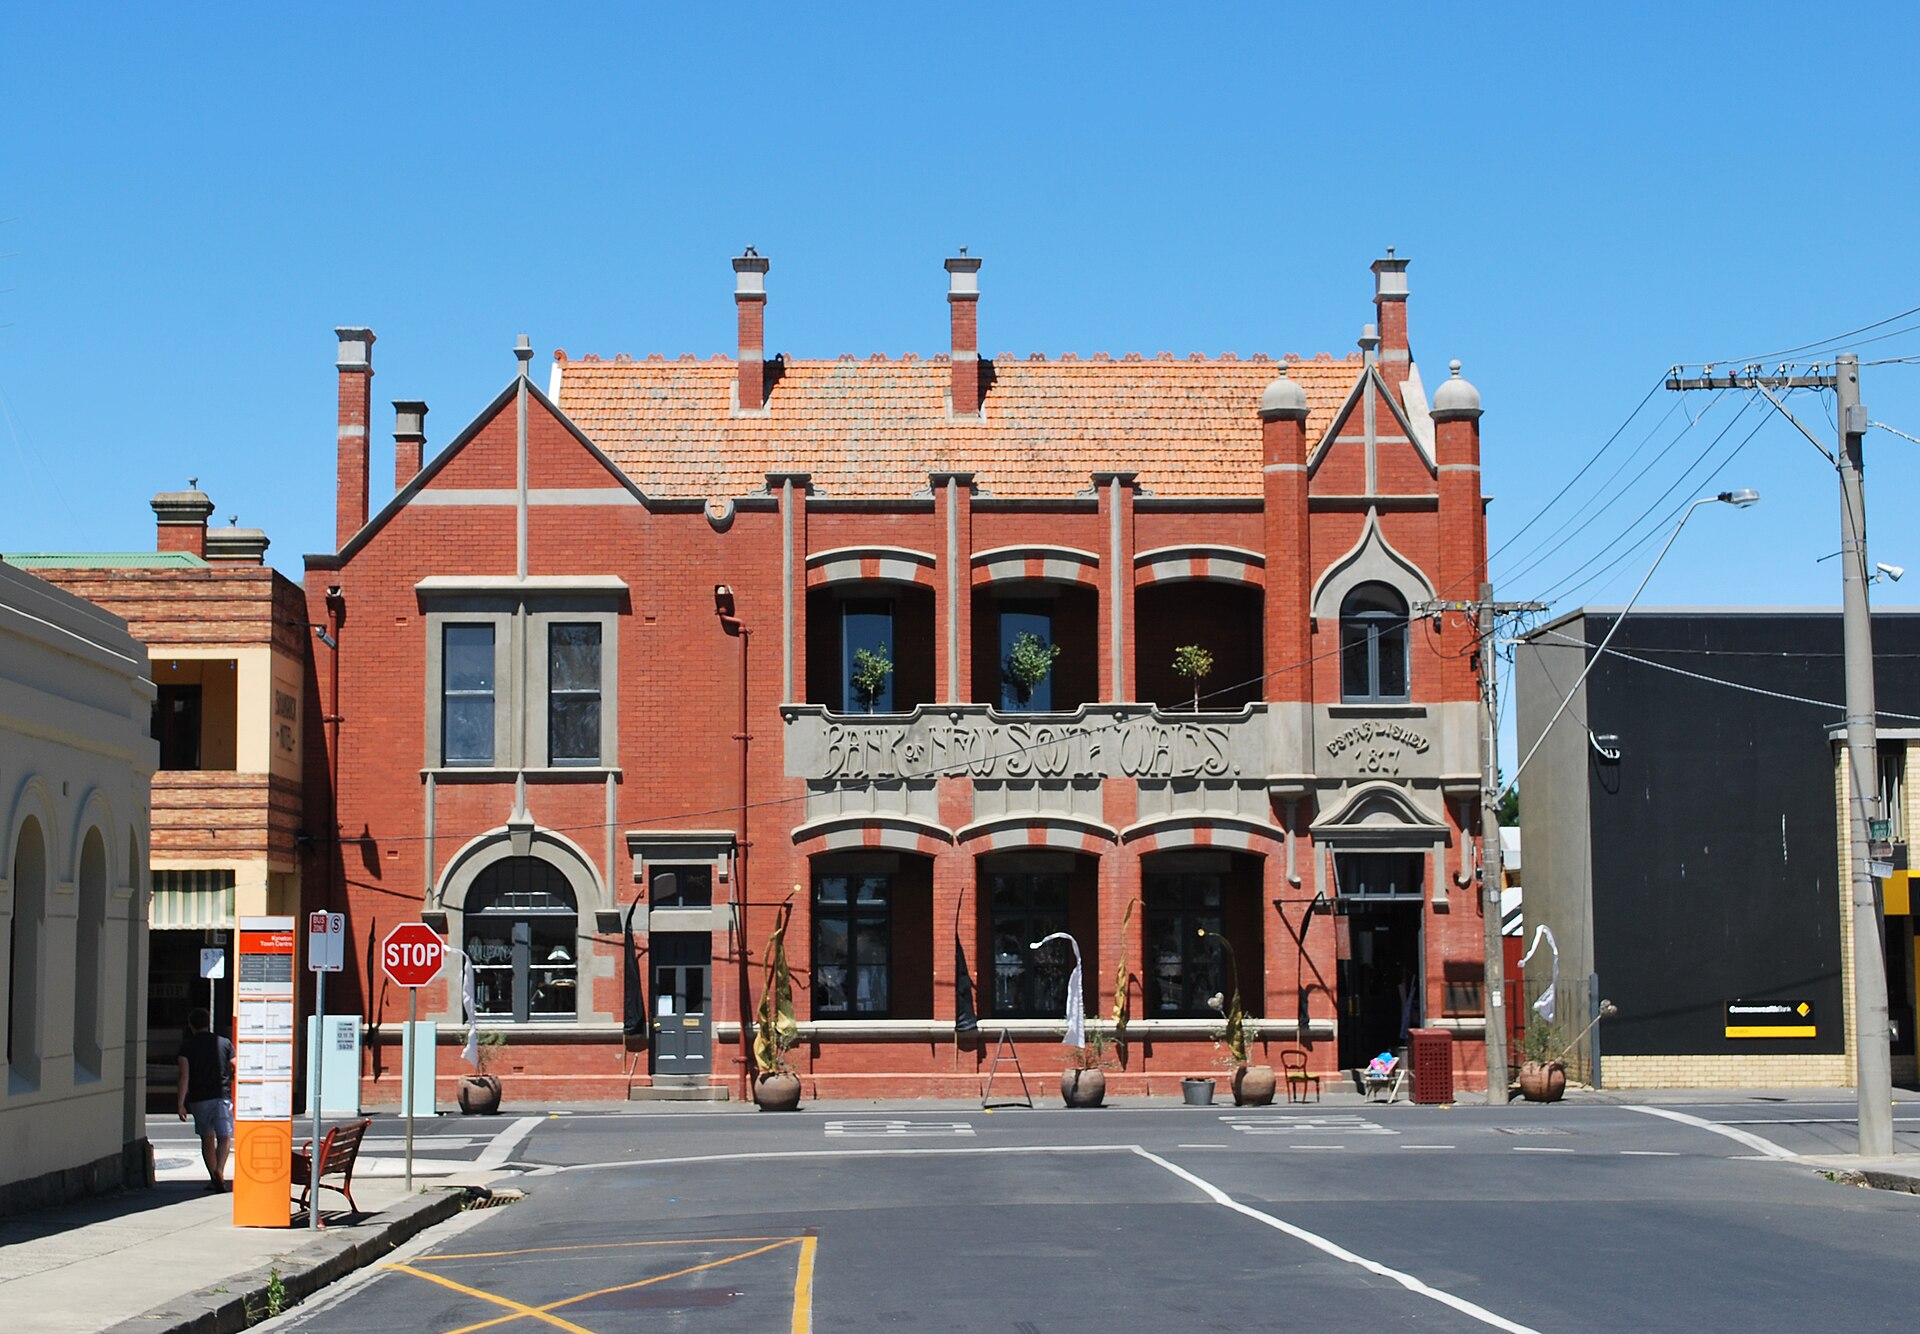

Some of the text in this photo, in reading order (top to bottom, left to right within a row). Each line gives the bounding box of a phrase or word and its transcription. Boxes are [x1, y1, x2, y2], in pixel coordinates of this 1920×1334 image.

[822, 723, 909, 780] BANK
[928, 727, 999, 779] NEW
[1005, 722, 1109, 779] SOUTH
[1326, 721, 1430, 758] ESTABLISHED
[1355, 748, 1400, 776] 1817
[312, 915, 325, 924] BUS
[313, 924, 325, 932] ZONE
[386, 943, 440, 967] STOP
